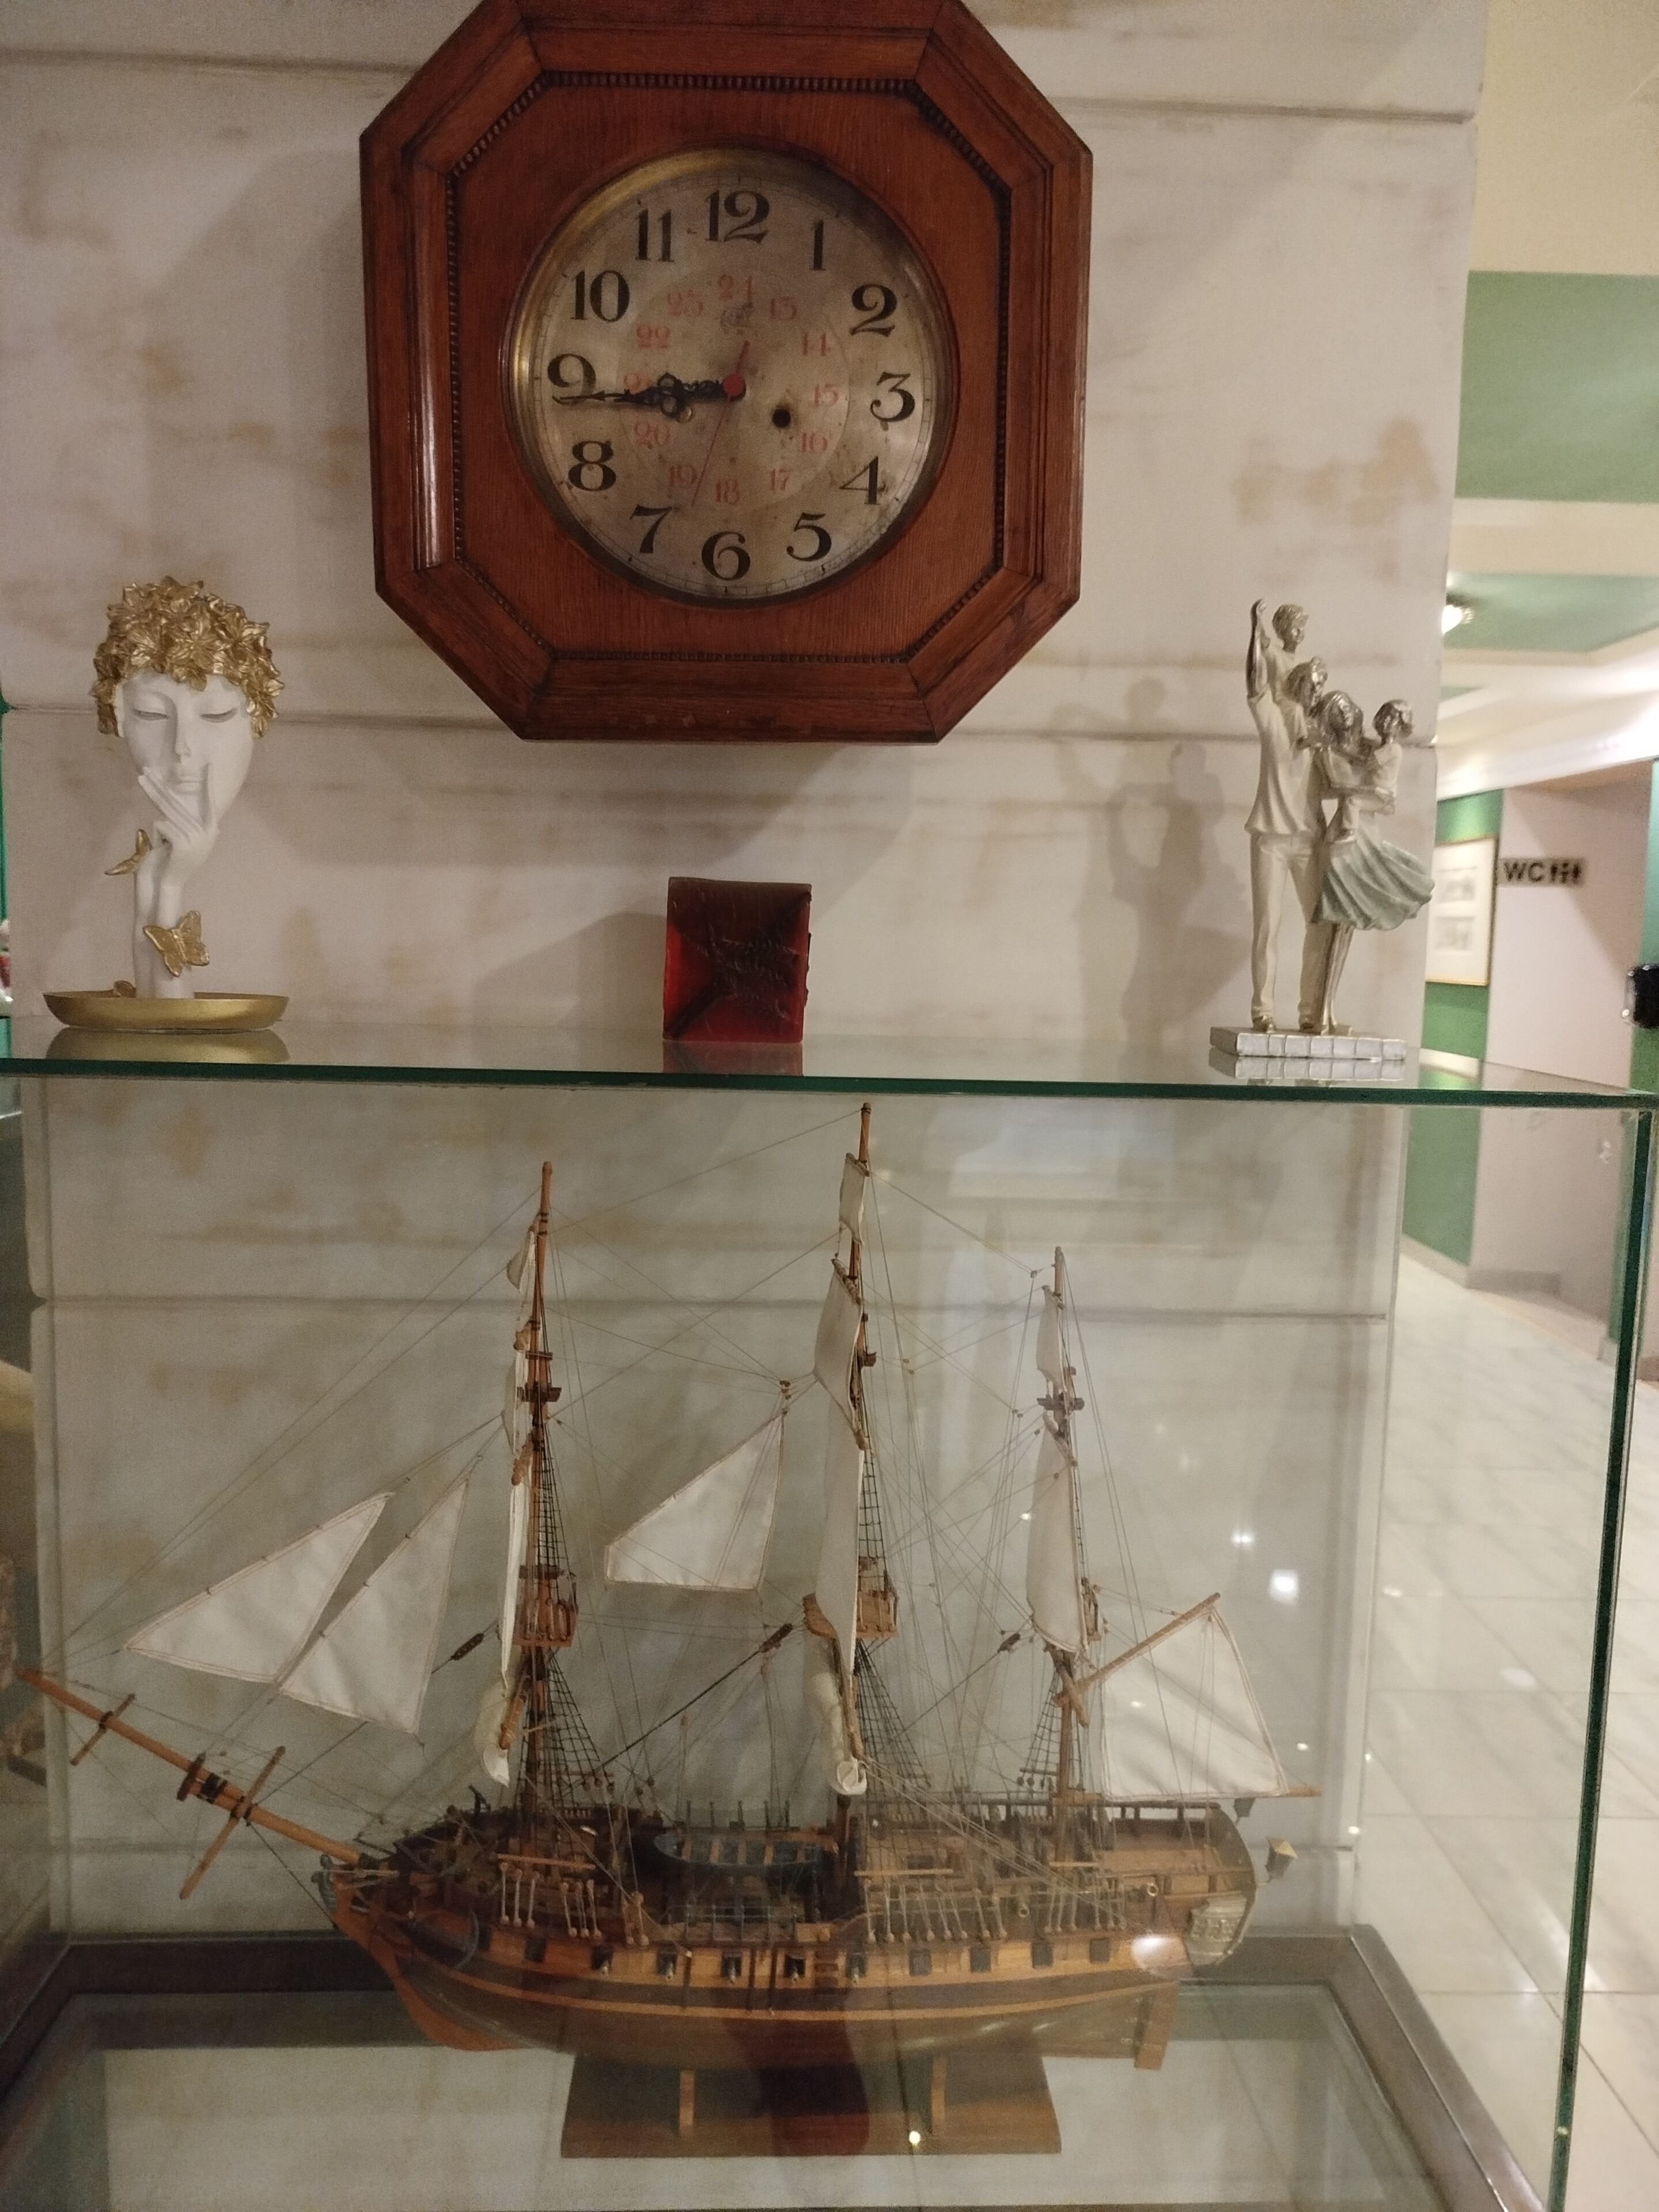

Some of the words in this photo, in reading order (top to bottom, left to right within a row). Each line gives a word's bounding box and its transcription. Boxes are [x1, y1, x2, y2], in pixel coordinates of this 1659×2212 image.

[635, 208, 675, 262] 11
[705, 190, 770, 243] 12
[809, 219, 827, 271] 1
[571, 270, 630, 323] 10
[850, 285, 897, 336] 2
[547, 354, 597, 404] 9
[814, 384, 840, 408] 15
[870, 372, 915, 423] 3
[568, 441, 616, 491] 8
[769, 468, 793, 491] 17
[839, 456, 886, 505] 4
[715, 479, 740, 505] 18
[630, 505, 676, 554] 7
[786, 512, 832, 562] 5
[702, 531, 751, 581] 6
[1503, 862, 1544, 882] WC
